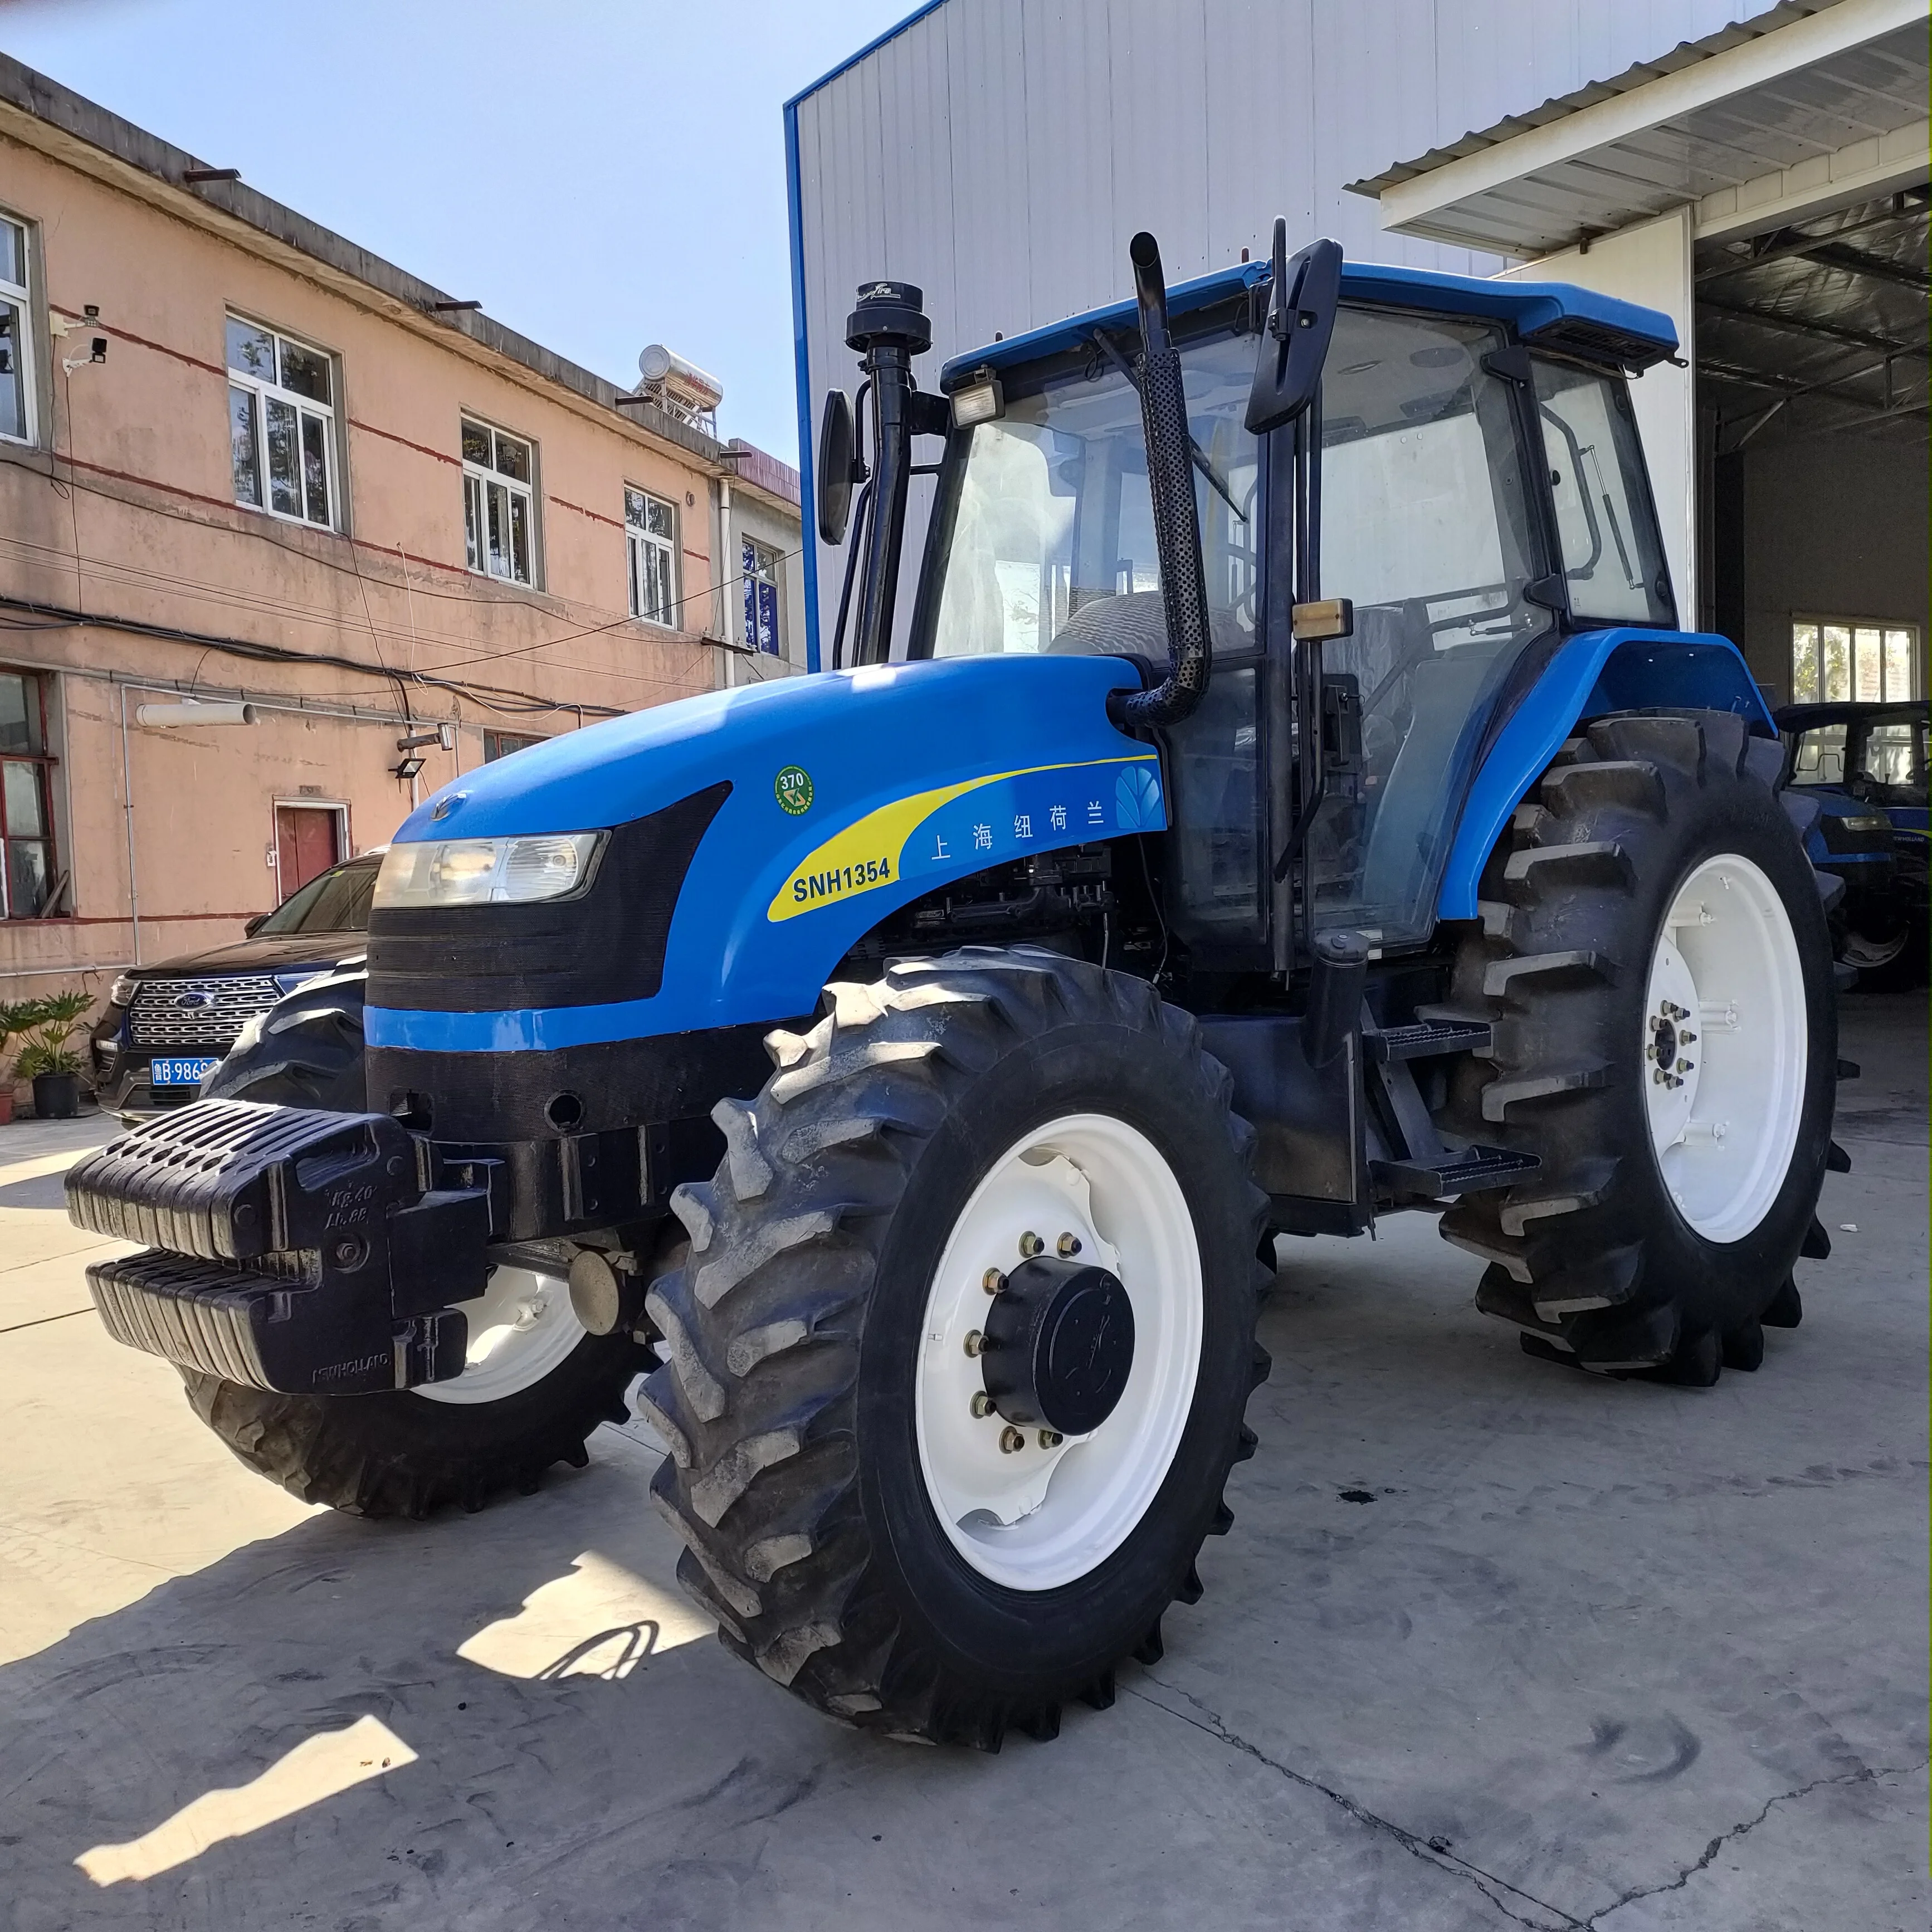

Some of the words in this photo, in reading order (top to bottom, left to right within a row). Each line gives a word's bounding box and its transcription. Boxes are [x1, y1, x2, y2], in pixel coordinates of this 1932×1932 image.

[780, 773, 804, 790] 370
[931, 801, 1104, 861] 上海纽荷兰
[793, 857, 891, 902] SNH1354
[181, 996, 200, 1006] Ford
